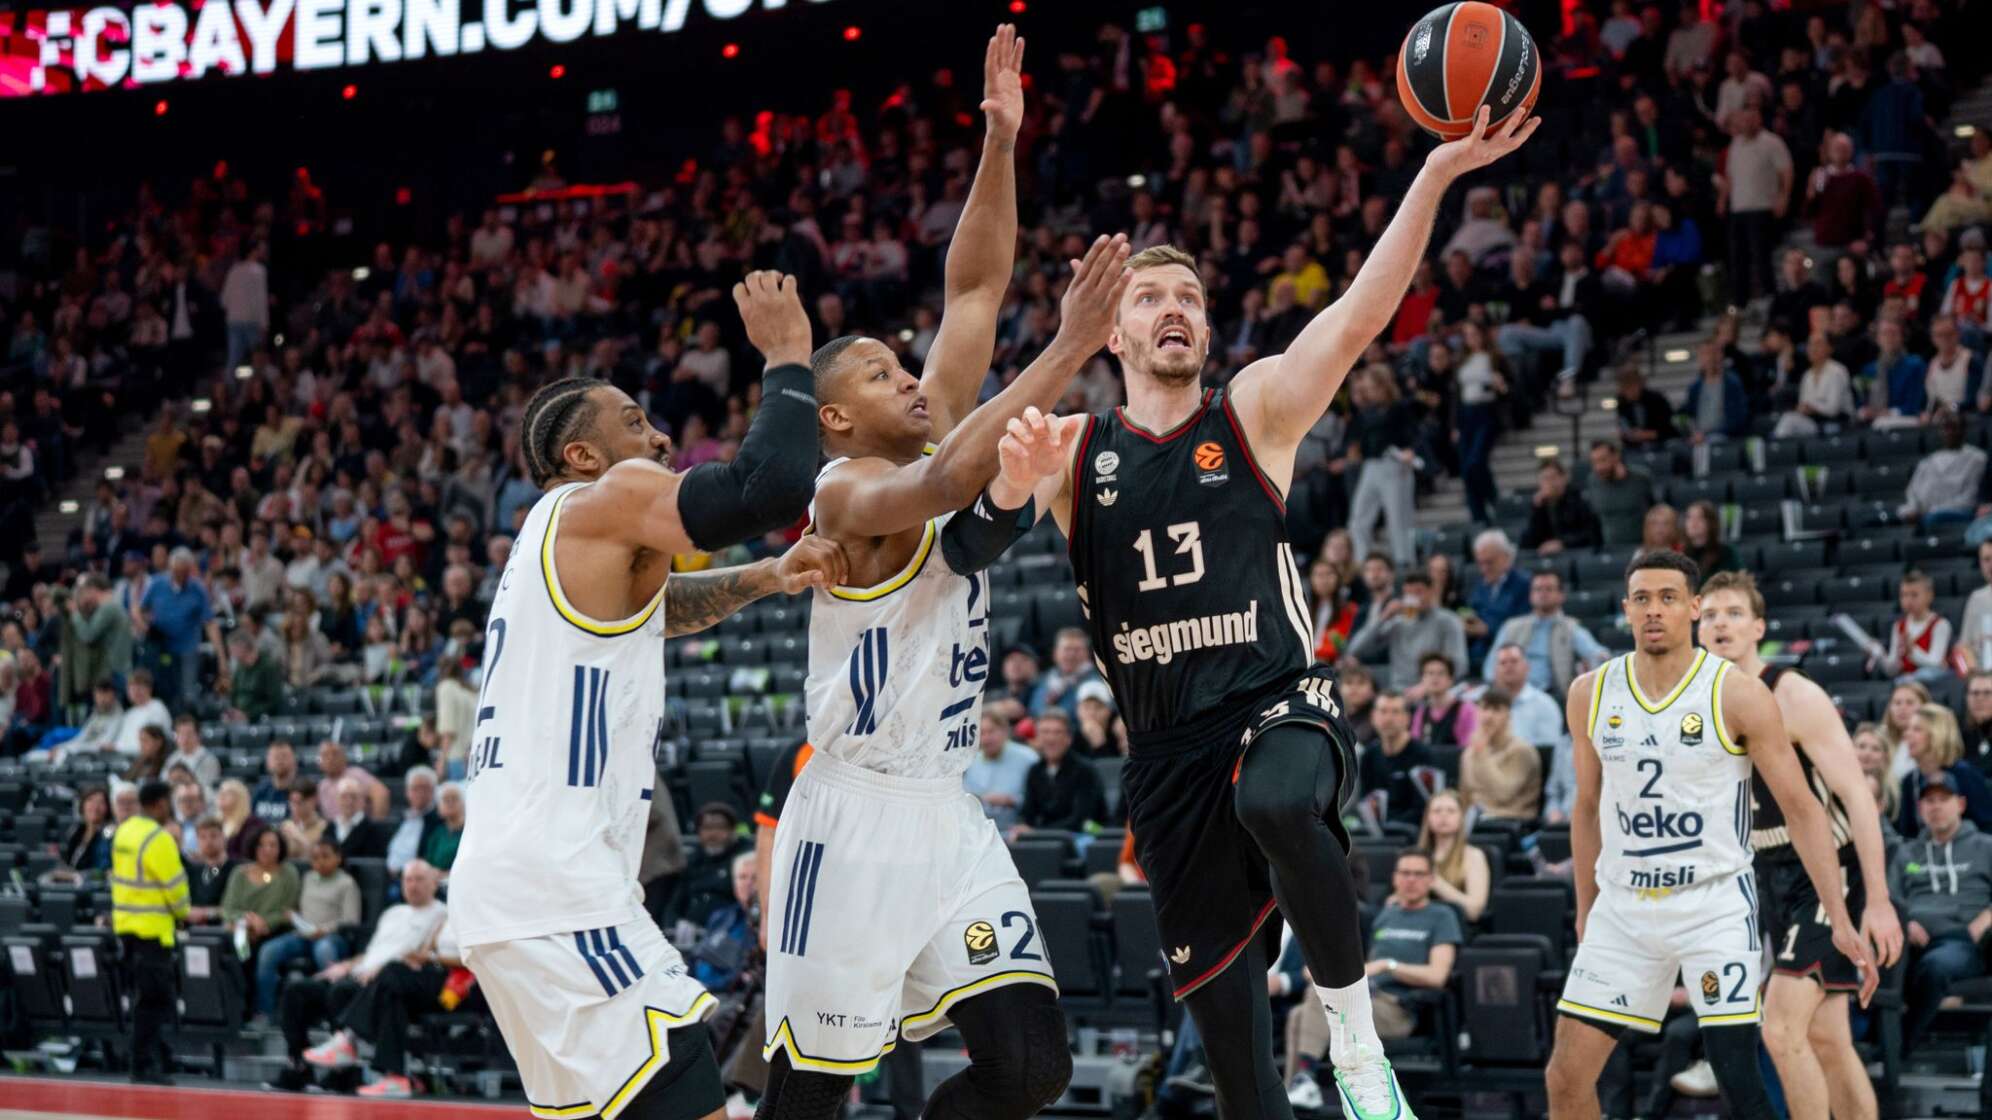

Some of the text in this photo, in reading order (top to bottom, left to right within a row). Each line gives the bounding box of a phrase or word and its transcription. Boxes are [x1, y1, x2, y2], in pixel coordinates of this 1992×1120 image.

[1132, 520, 1206, 593] 13
[1112, 599, 1259, 666] siegmund
[949, 632, 990, 689] be
[1636, 757, 1665, 799] 2
[1616, 801, 1705, 838] beko
[1629, 865, 1696, 889] misli
[1723, 962, 1750, 1004] 2
[816, 1011, 847, 1028] YKT
